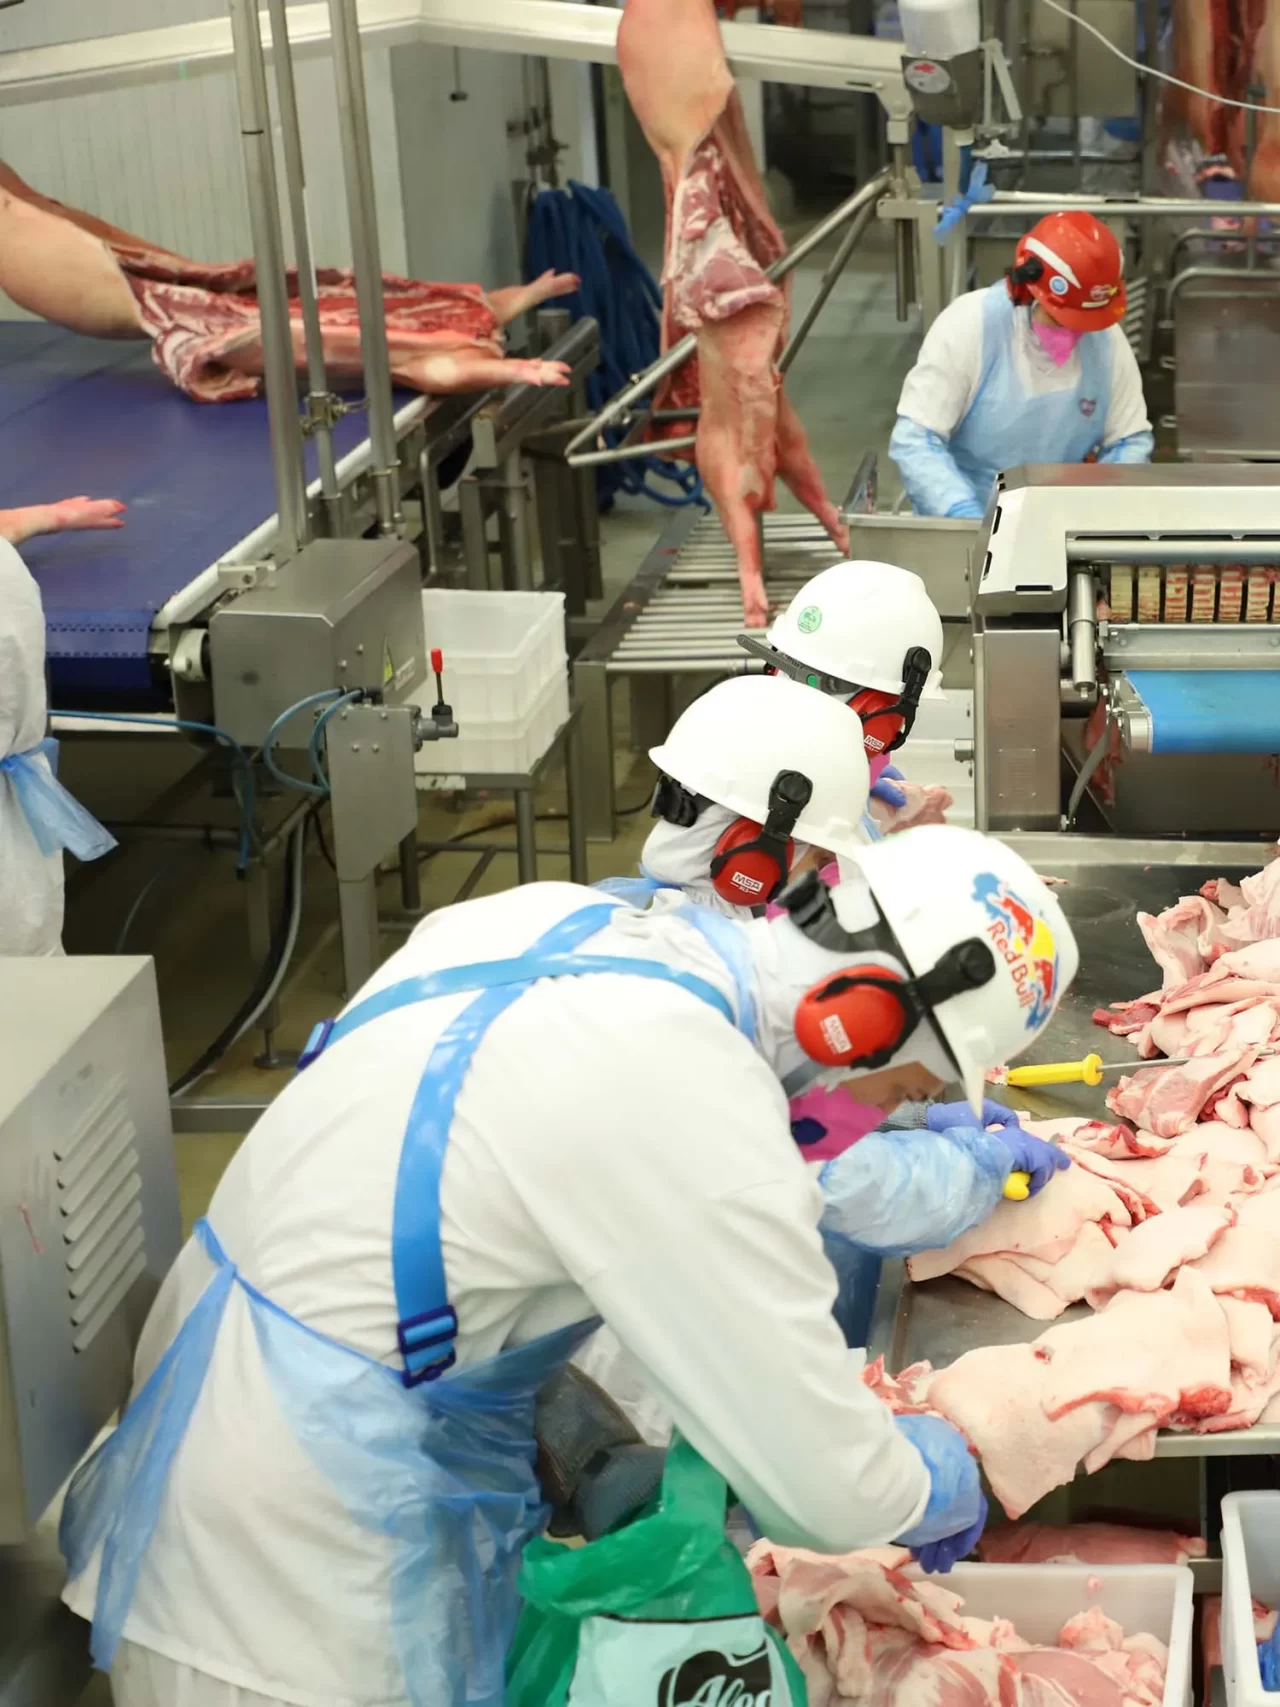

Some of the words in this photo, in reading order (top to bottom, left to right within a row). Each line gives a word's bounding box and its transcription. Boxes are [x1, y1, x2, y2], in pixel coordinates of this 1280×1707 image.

[865, 736, 884, 749] MSA
[734, 873, 761, 890] MSA
[986, 920, 1021, 965] Red
[1010, 961, 1036, 1008] Bull
